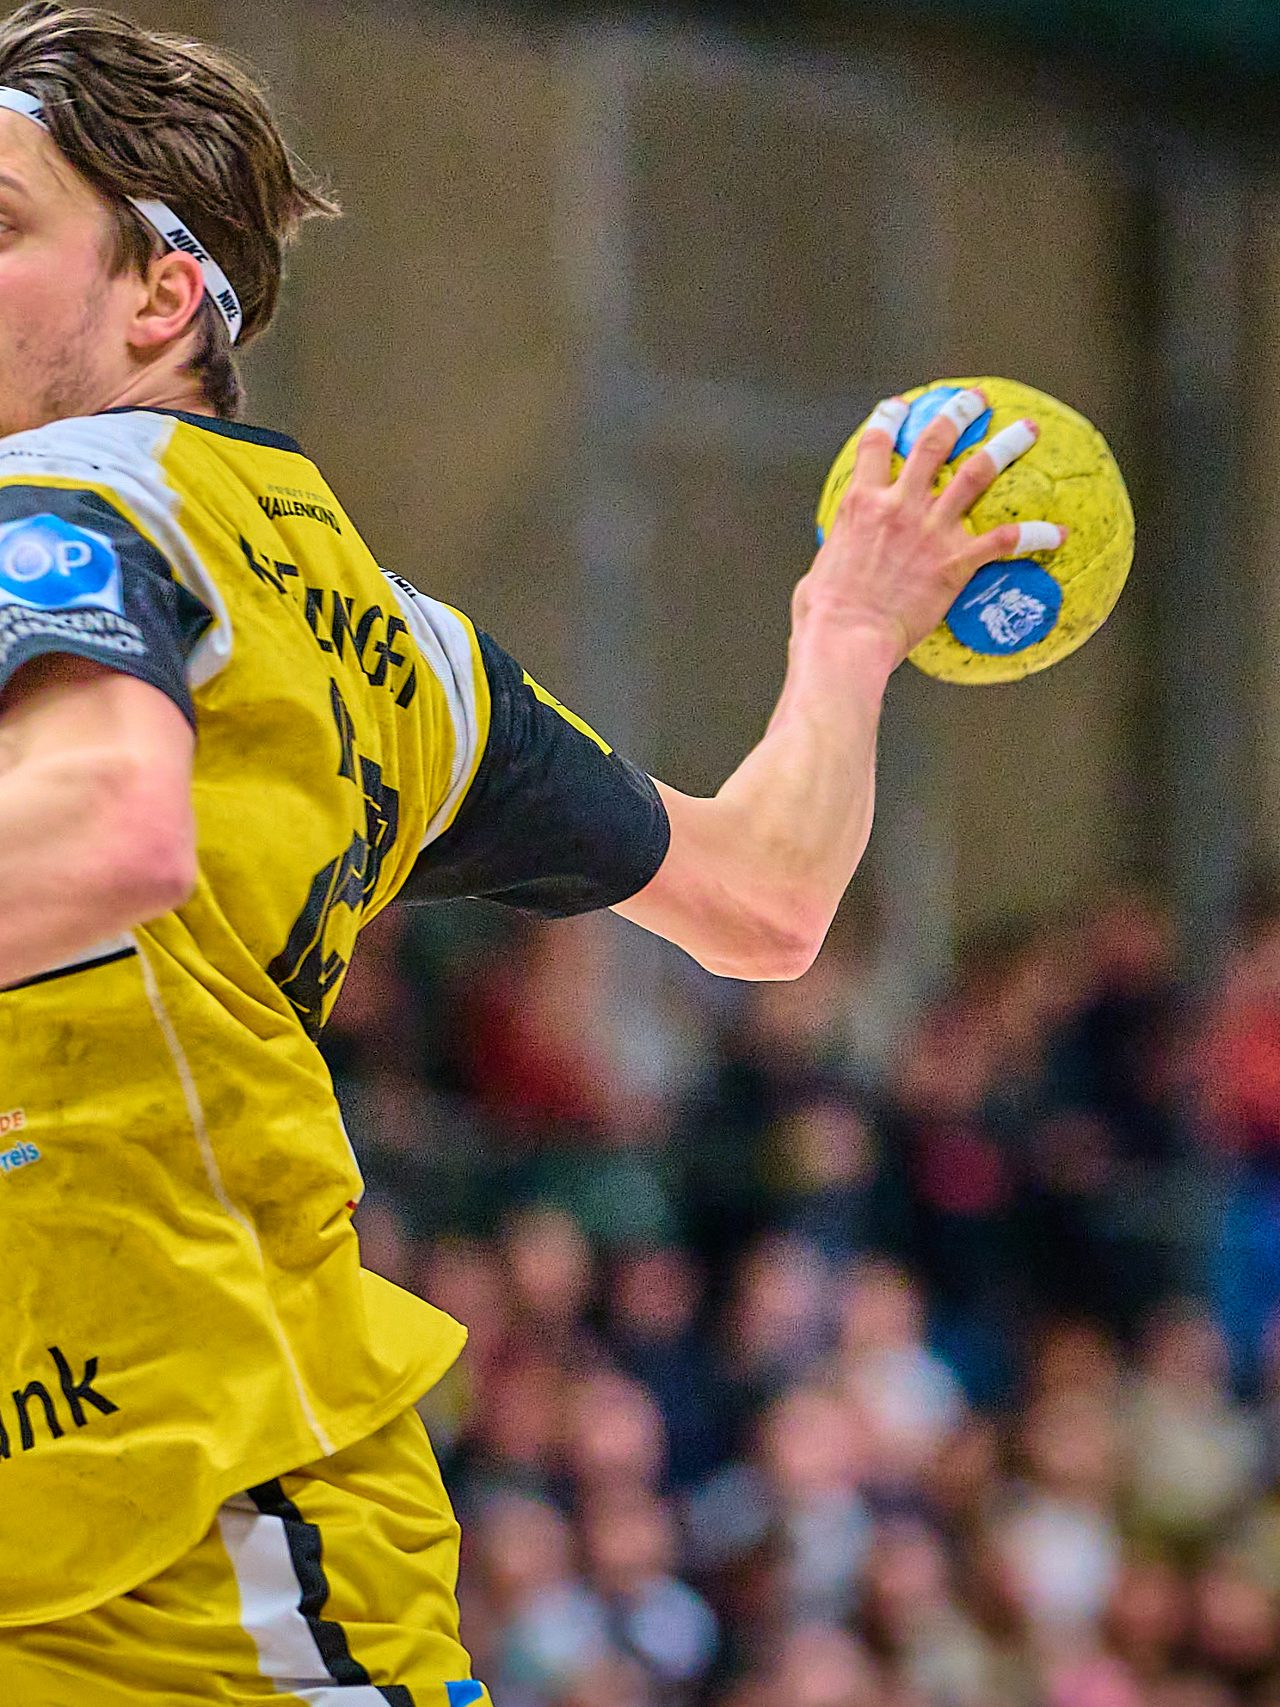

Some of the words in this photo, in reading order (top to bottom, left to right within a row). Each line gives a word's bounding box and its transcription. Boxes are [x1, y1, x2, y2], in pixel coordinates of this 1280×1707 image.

[166, 228, 210, 263] NIKE
[217, 289, 239, 322] NIKE
[4, 540, 93, 582] OP
